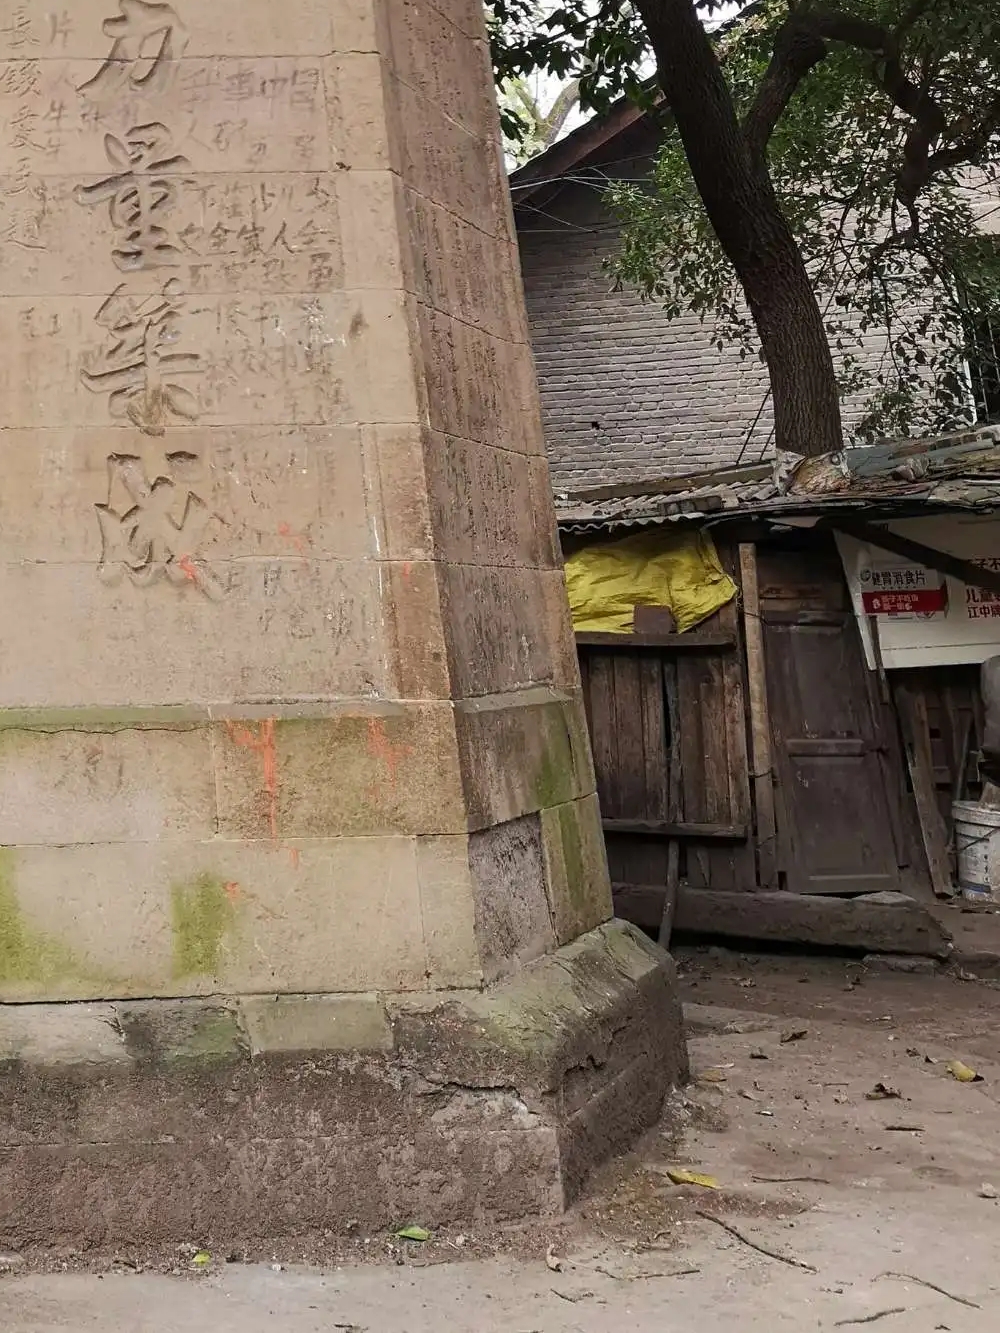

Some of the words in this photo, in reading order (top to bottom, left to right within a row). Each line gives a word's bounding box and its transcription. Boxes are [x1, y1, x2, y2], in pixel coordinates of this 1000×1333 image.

[872, 569, 927, 587] 健胃消食片
